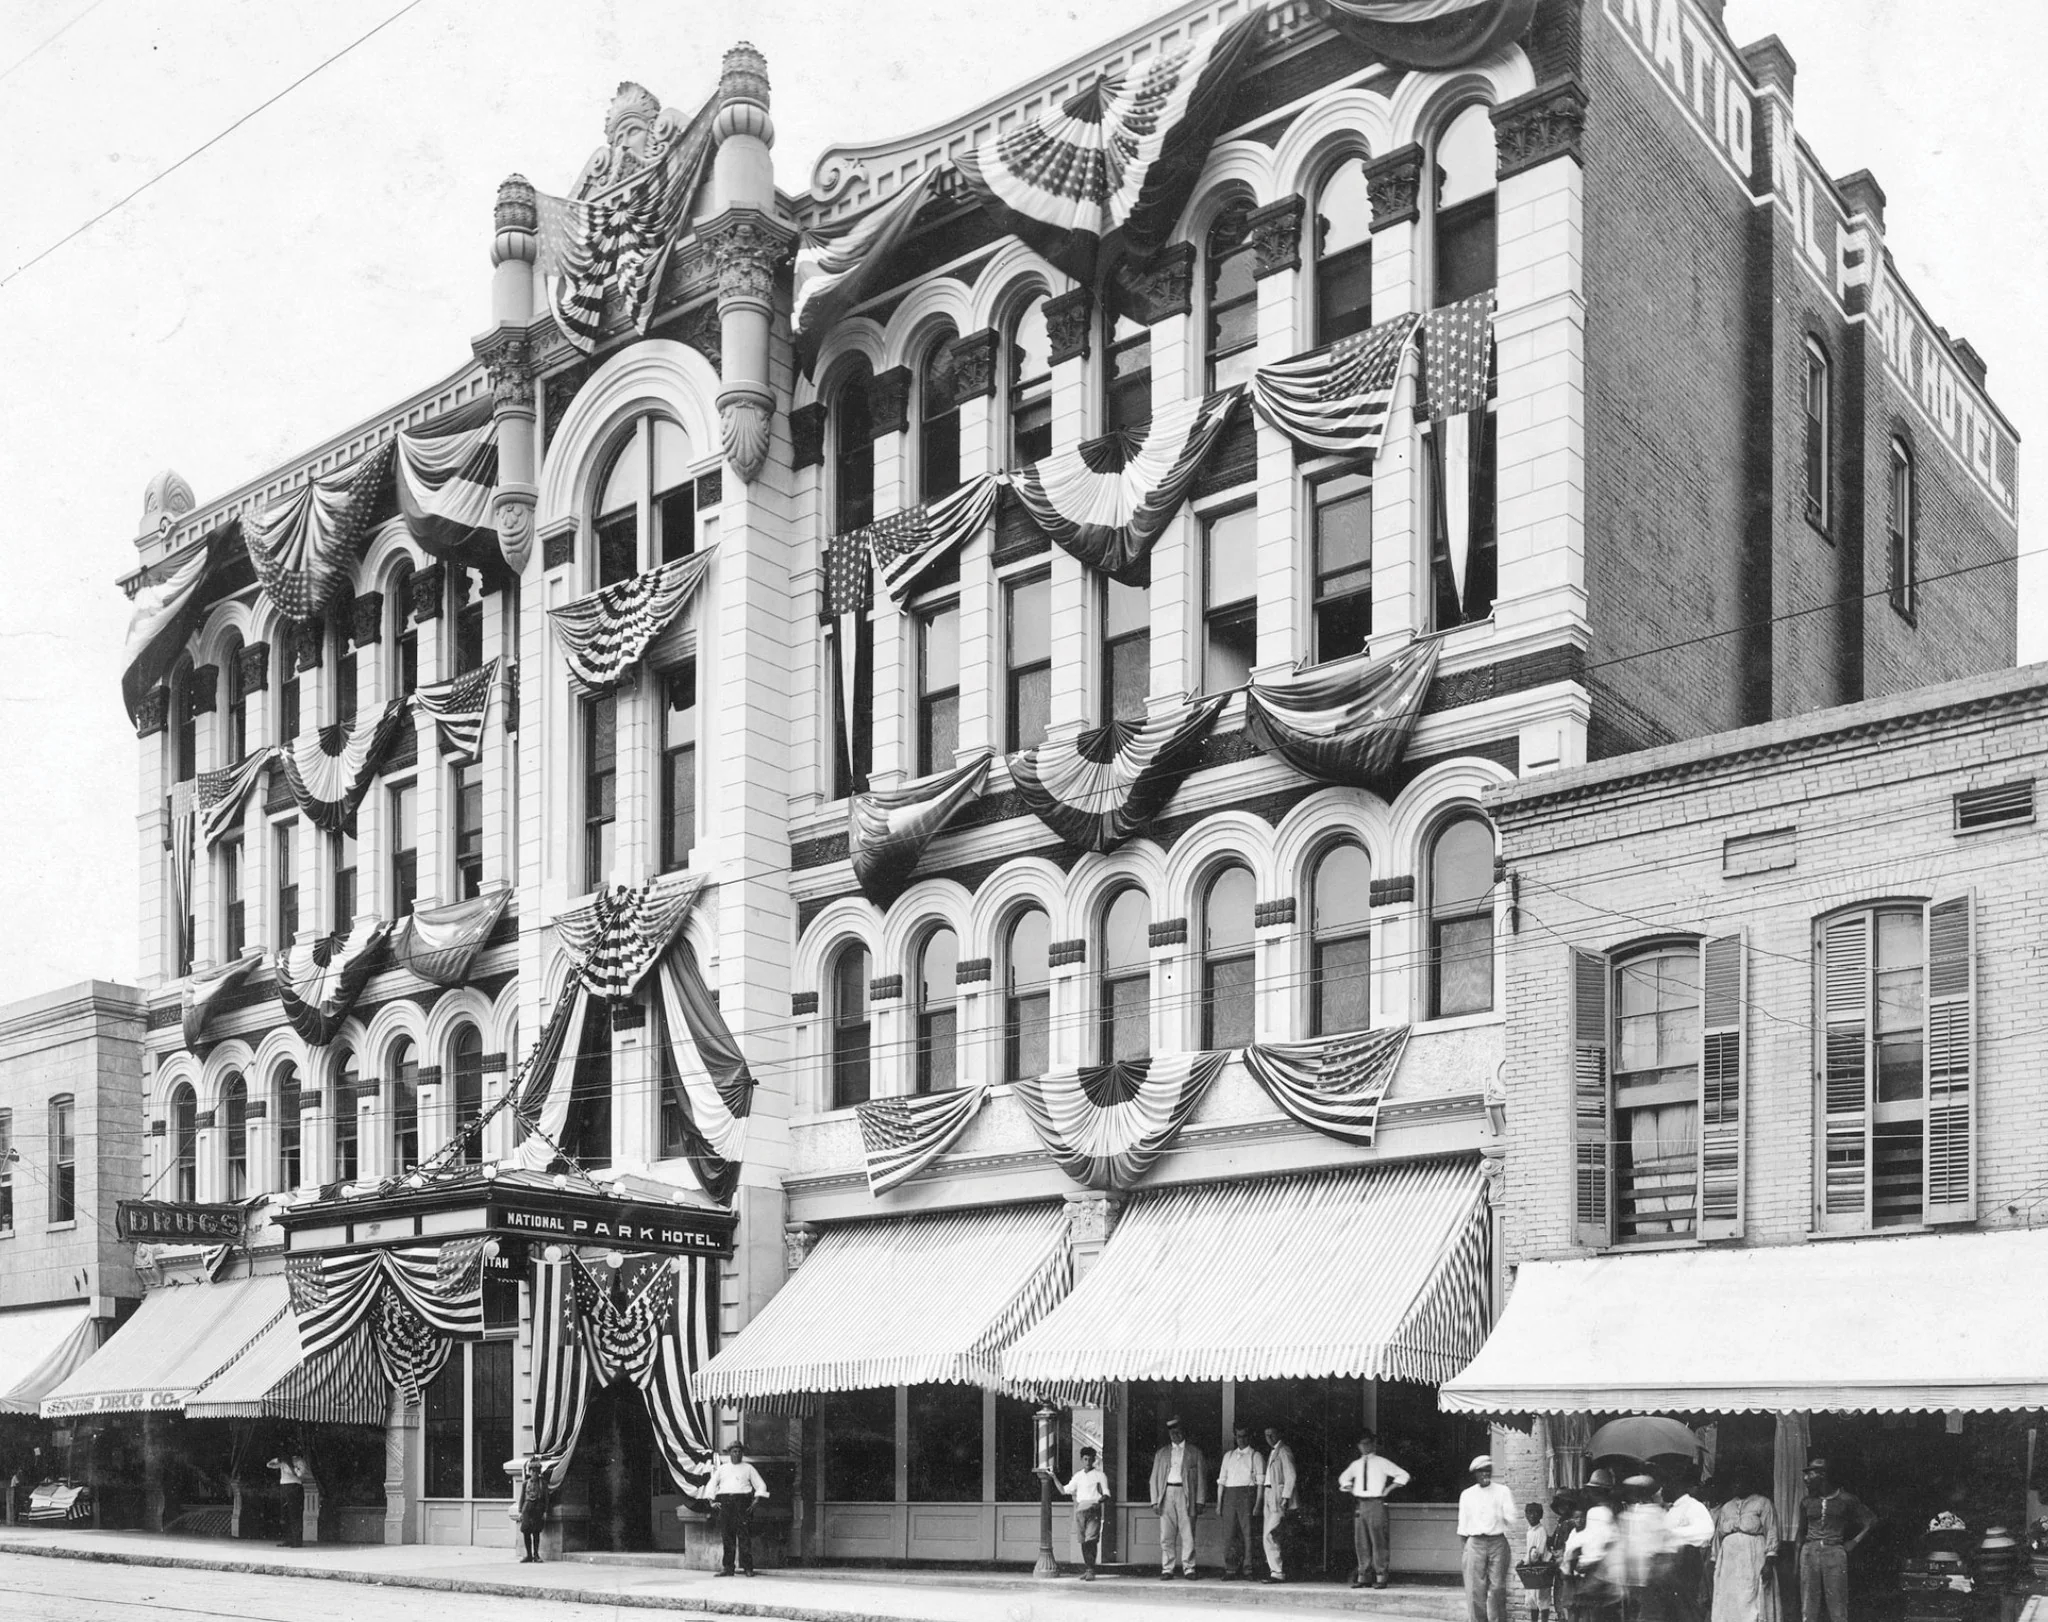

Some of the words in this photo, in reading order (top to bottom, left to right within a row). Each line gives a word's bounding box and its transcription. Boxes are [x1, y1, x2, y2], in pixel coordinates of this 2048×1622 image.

[130, 1210, 238, 1234] DRUGS
[507, 1212, 564, 1230] NATIONAL
[573, 1219, 653, 1240] PARK
[100, 1394, 144, 1410] DRUG
